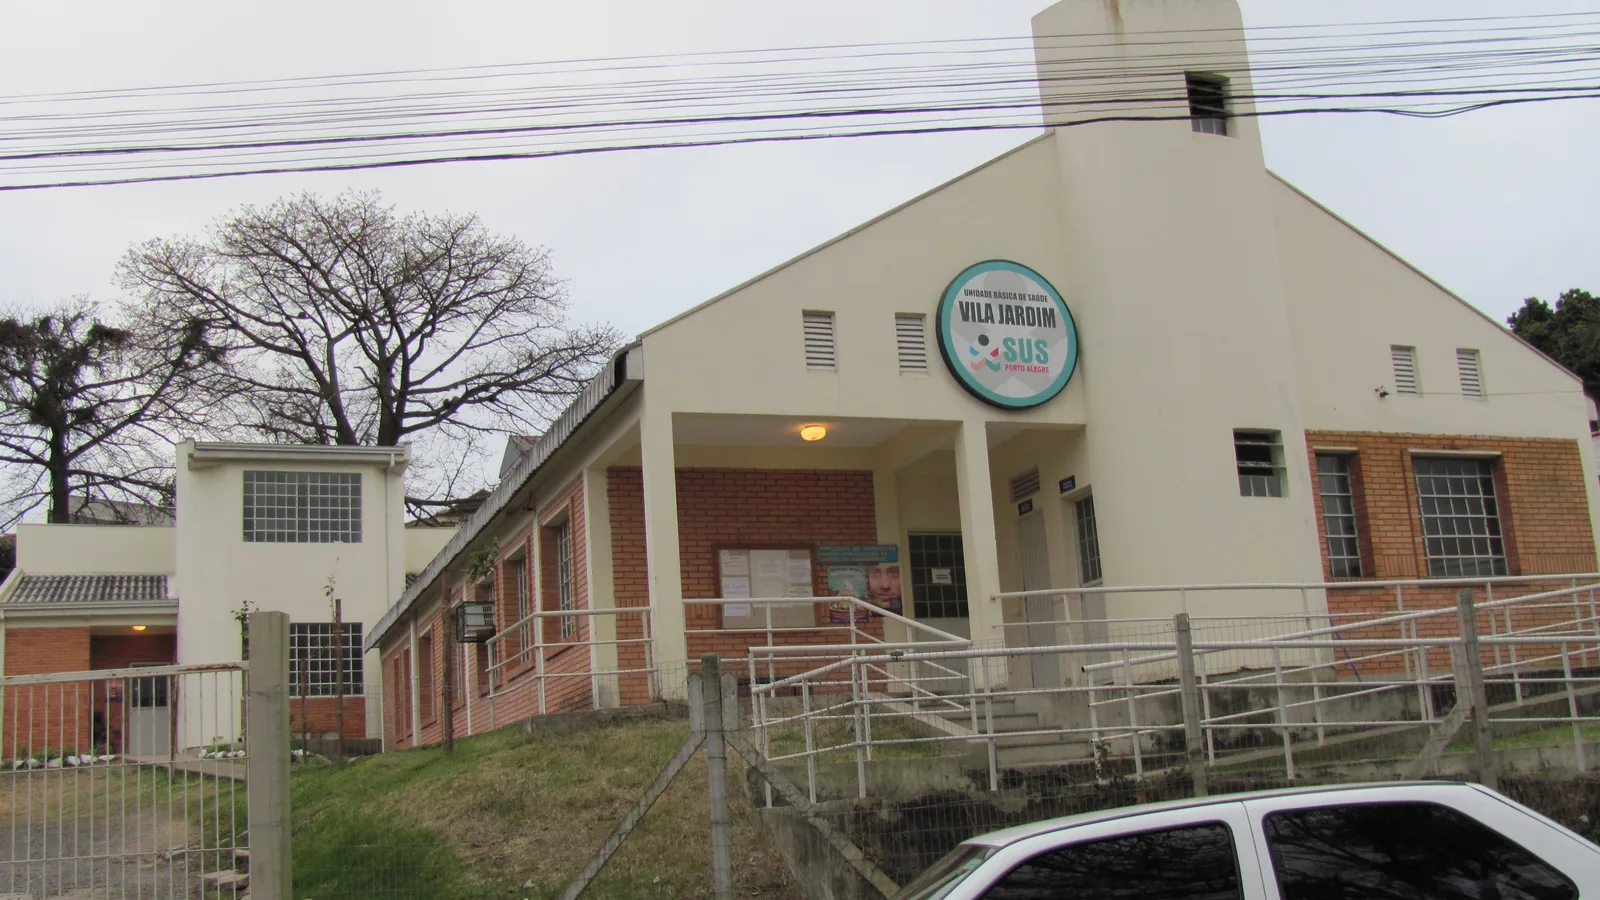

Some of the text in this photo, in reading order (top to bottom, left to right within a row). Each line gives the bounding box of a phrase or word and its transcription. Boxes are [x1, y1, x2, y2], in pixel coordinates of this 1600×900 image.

[964, 288, 1048, 303] UNIDADE BÁSICA DE SAÚDE
[958, 300, 1056, 328] VILA JARDIM
[1003, 337, 1049, 364] SUS
[1005, 364, 1049, 373] PORTO ALEGRE
